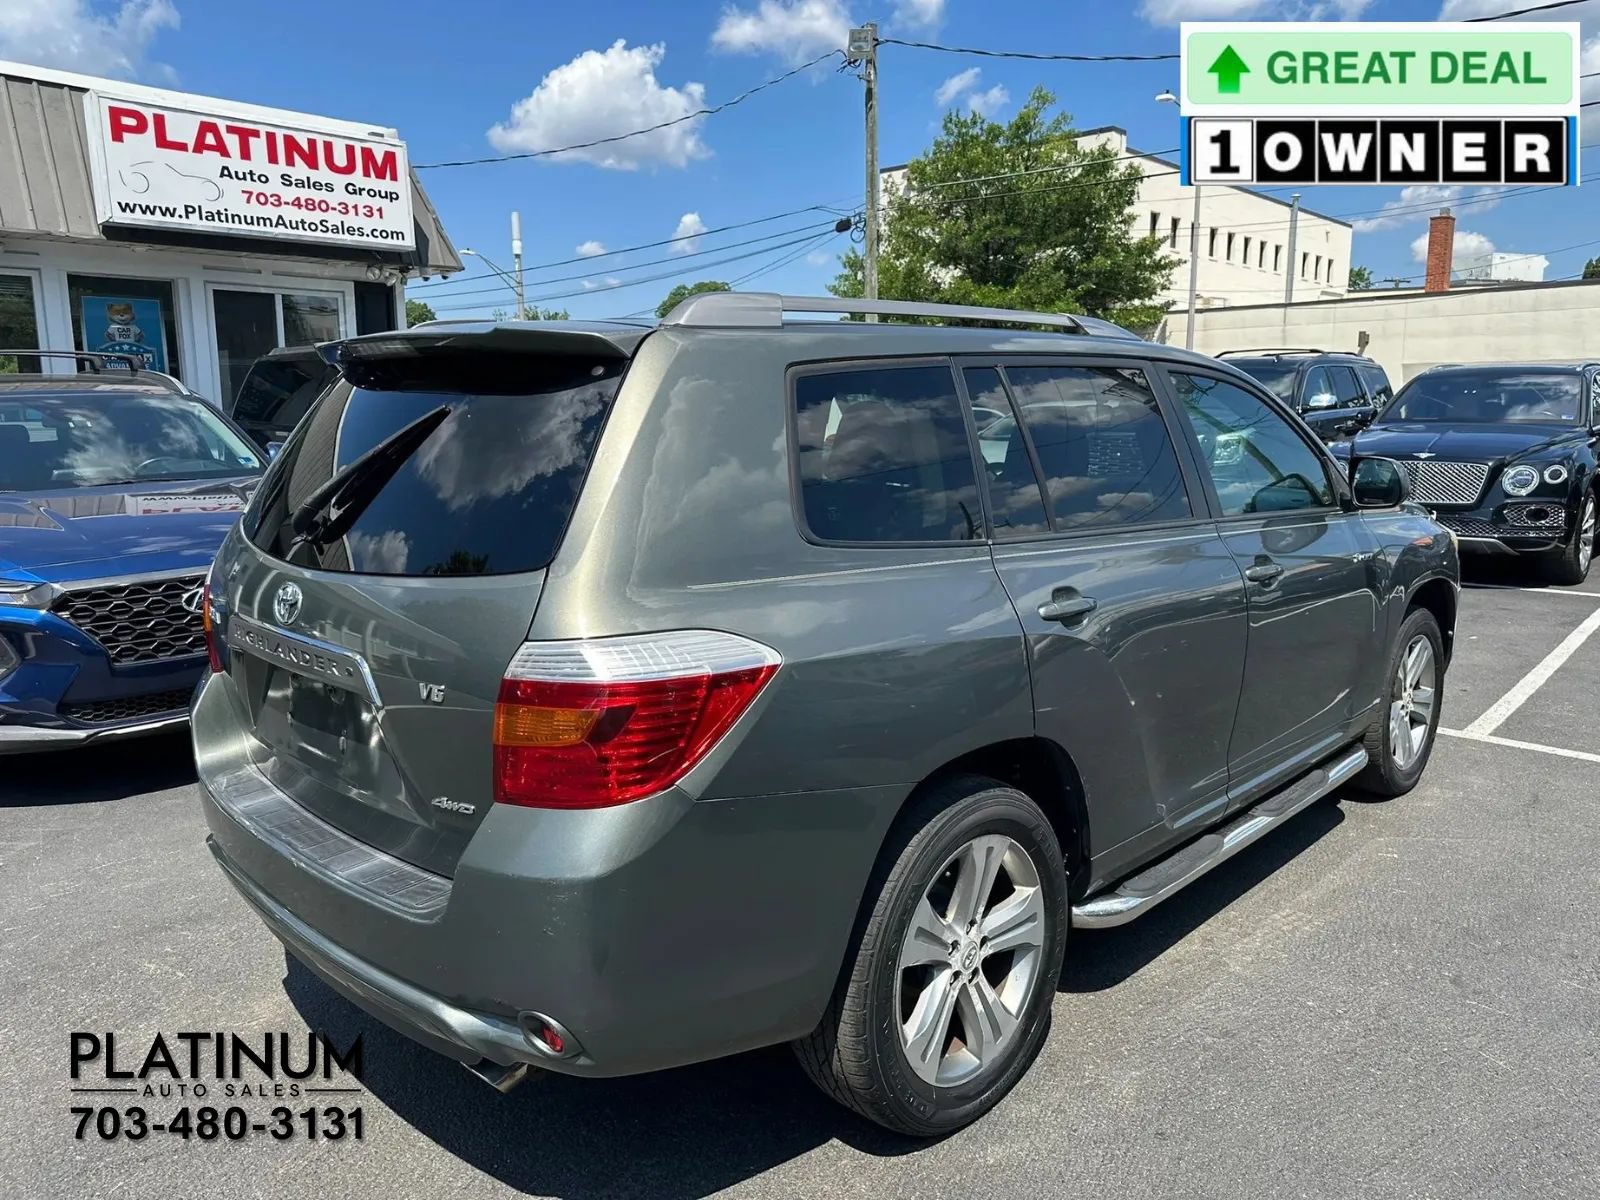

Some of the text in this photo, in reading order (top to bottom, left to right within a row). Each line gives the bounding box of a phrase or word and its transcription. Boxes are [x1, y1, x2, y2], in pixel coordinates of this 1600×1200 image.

[108, 105, 398, 182] PLATINUM
[219, 165, 400, 203] Auto Sales Group
[117, 201, 405, 242] www.PlatinumAutoSales.com
[241, 189, 384, 220] 703-480-3131
[233, 623, 341, 677] HIGHLANDER
[419, 682, 446, 703] V6
[431, 797, 476, 815] 4WD
